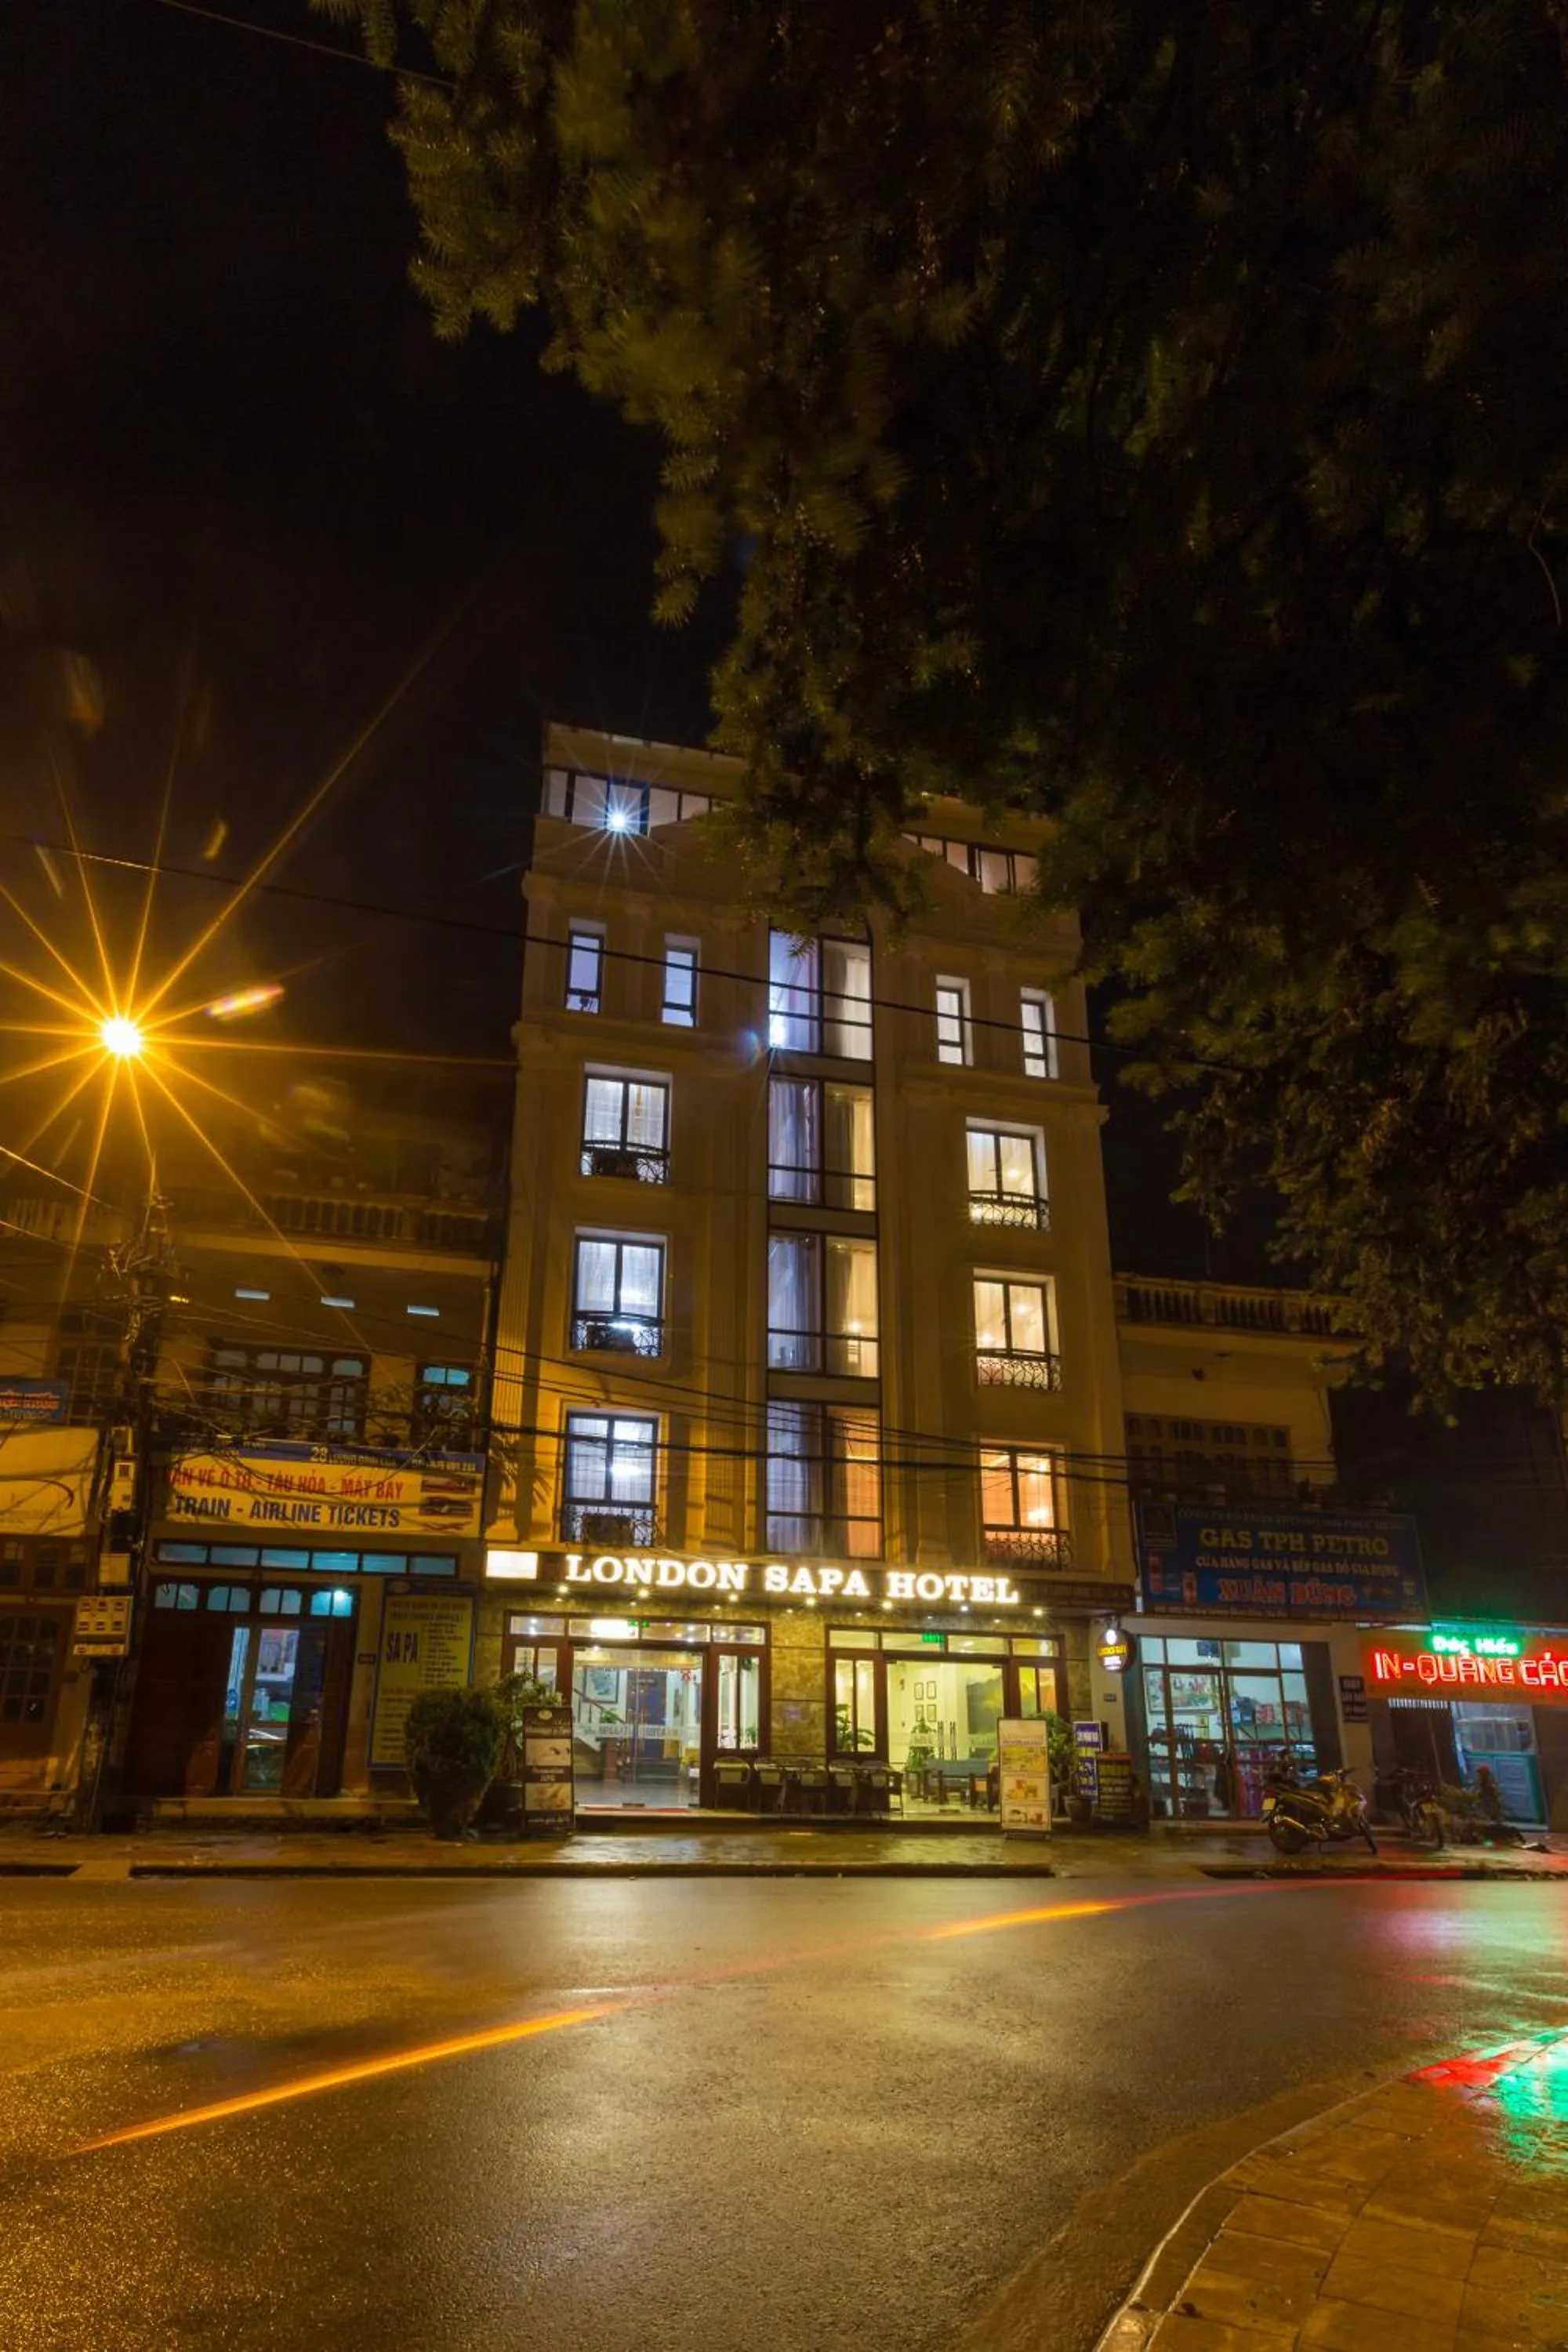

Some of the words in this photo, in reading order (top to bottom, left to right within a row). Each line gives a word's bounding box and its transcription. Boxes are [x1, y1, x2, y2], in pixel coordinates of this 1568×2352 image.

[310, 1446, 328, 1463] 28
[376, 1481, 404, 1500] BAY
[176, 1495, 231, 1517] TRAIN
[250, 1498, 322, 1523] AIRLINE
[329, 1504, 400, 1528] TICKETS
[1200, 1527, 1253, 1549] GAS
[1258, 1530, 1306, 1552] TPH
[1312, 1534, 1388, 1556] PETRO
[565, 1555, 750, 1592] LONDON
[764, 1564, 872, 1597] SAPA
[886, 1572, 1018, 1604] HOTEL
[386, 1632, 400, 1663] SA
[404, 1632, 418, 1663] PA
